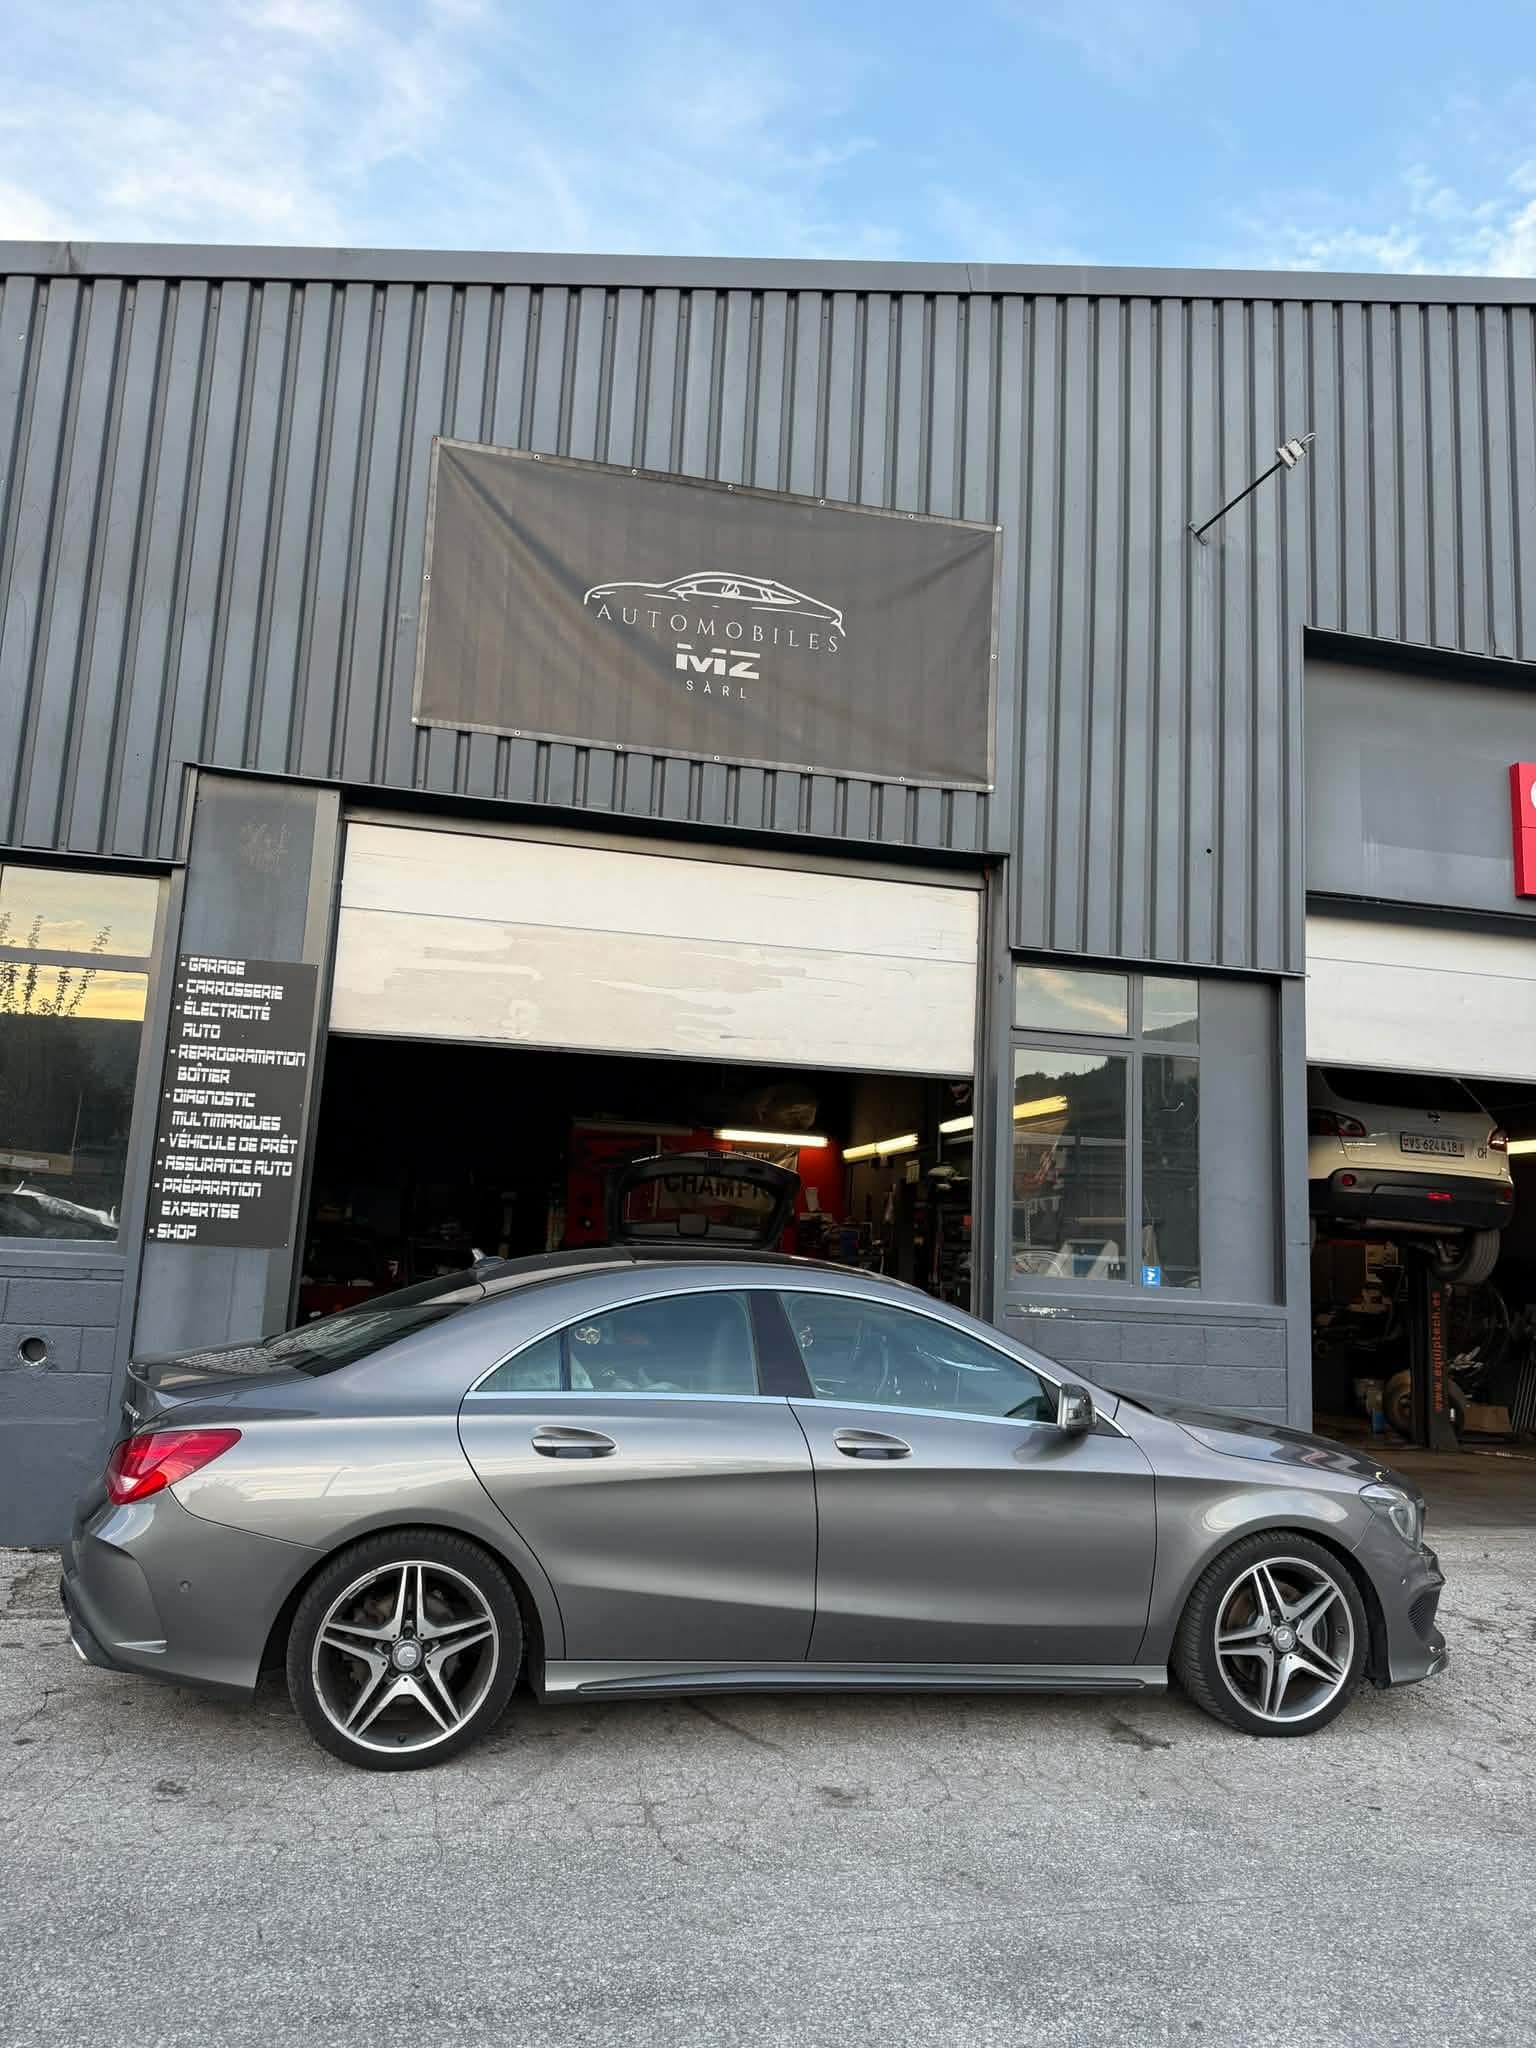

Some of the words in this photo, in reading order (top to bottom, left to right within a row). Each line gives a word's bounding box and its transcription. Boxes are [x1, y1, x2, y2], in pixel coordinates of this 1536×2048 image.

[596, 604, 839, 653] AUTOMOBILES
[675, 643, 761, 681] MZ
[188, 957, 245, 976] GARAGE
[186, 979, 284, 1000] CARROSSERIE
[183, 996, 271, 1021] ÉLECTRICITÉ
[182, 1023, 221, 1039] AUTO
[178, 1044, 306, 1067] REPROGRAMATION
[177, 1063, 231, 1084] BOÎTIER
[173, 1088, 256, 1107] DIAGNOSTIC
[172, 1111, 281, 1131] MULTIMARQUES
[169, 1129, 237, 1151] VÉHICULE
[239, 1136, 258, 1153] DE
[260, 1134, 298, 1154] PRÊT
[165, 1155, 252, 1175] ASSURANCE
[254, 1160, 292, 1176] AUTO
[162, 1173, 263, 1197] PRÉPARATION
[161, 1200, 240, 1219] EXPERTISE
[157, 1223, 197, 1239] SHOP
